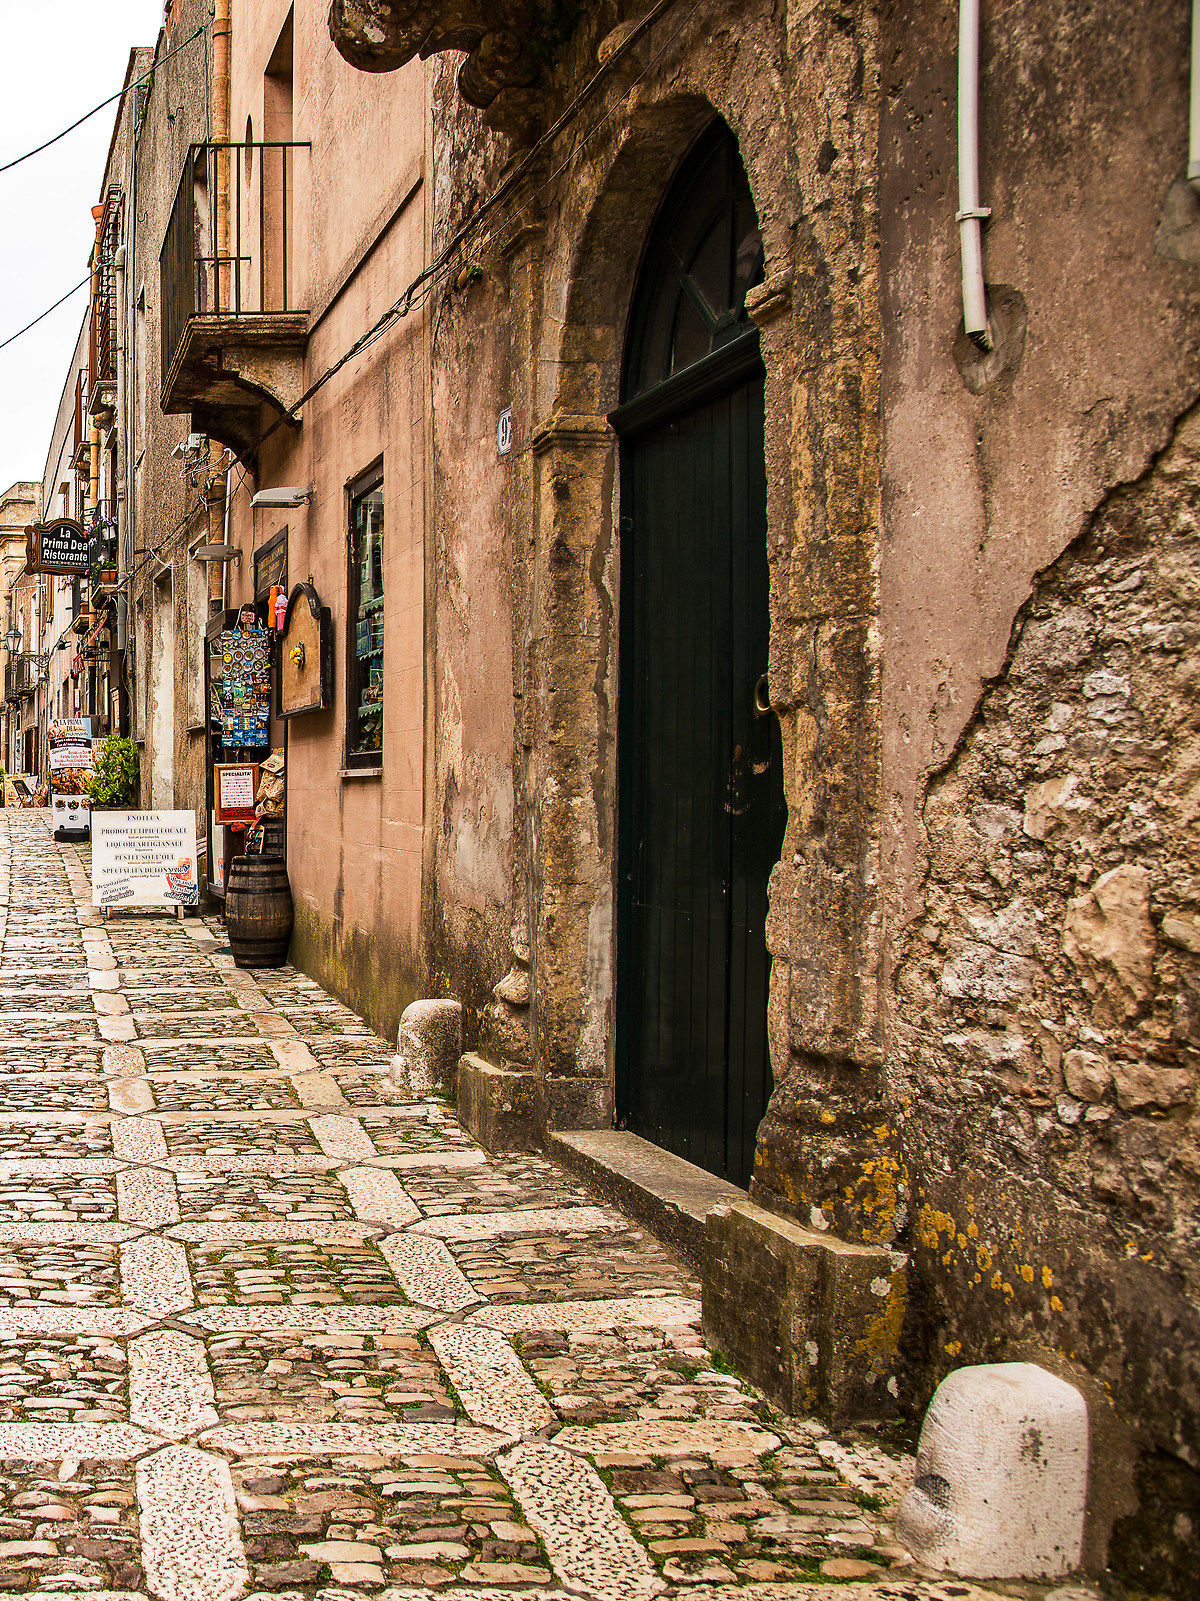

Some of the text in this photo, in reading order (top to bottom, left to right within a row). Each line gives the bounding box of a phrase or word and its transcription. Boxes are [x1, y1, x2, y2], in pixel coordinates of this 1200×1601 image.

[60, 527, 70, 538] La
[42, 538, 88, 550] Prima Dea
[43, 549, 88, 562] Ristorante
